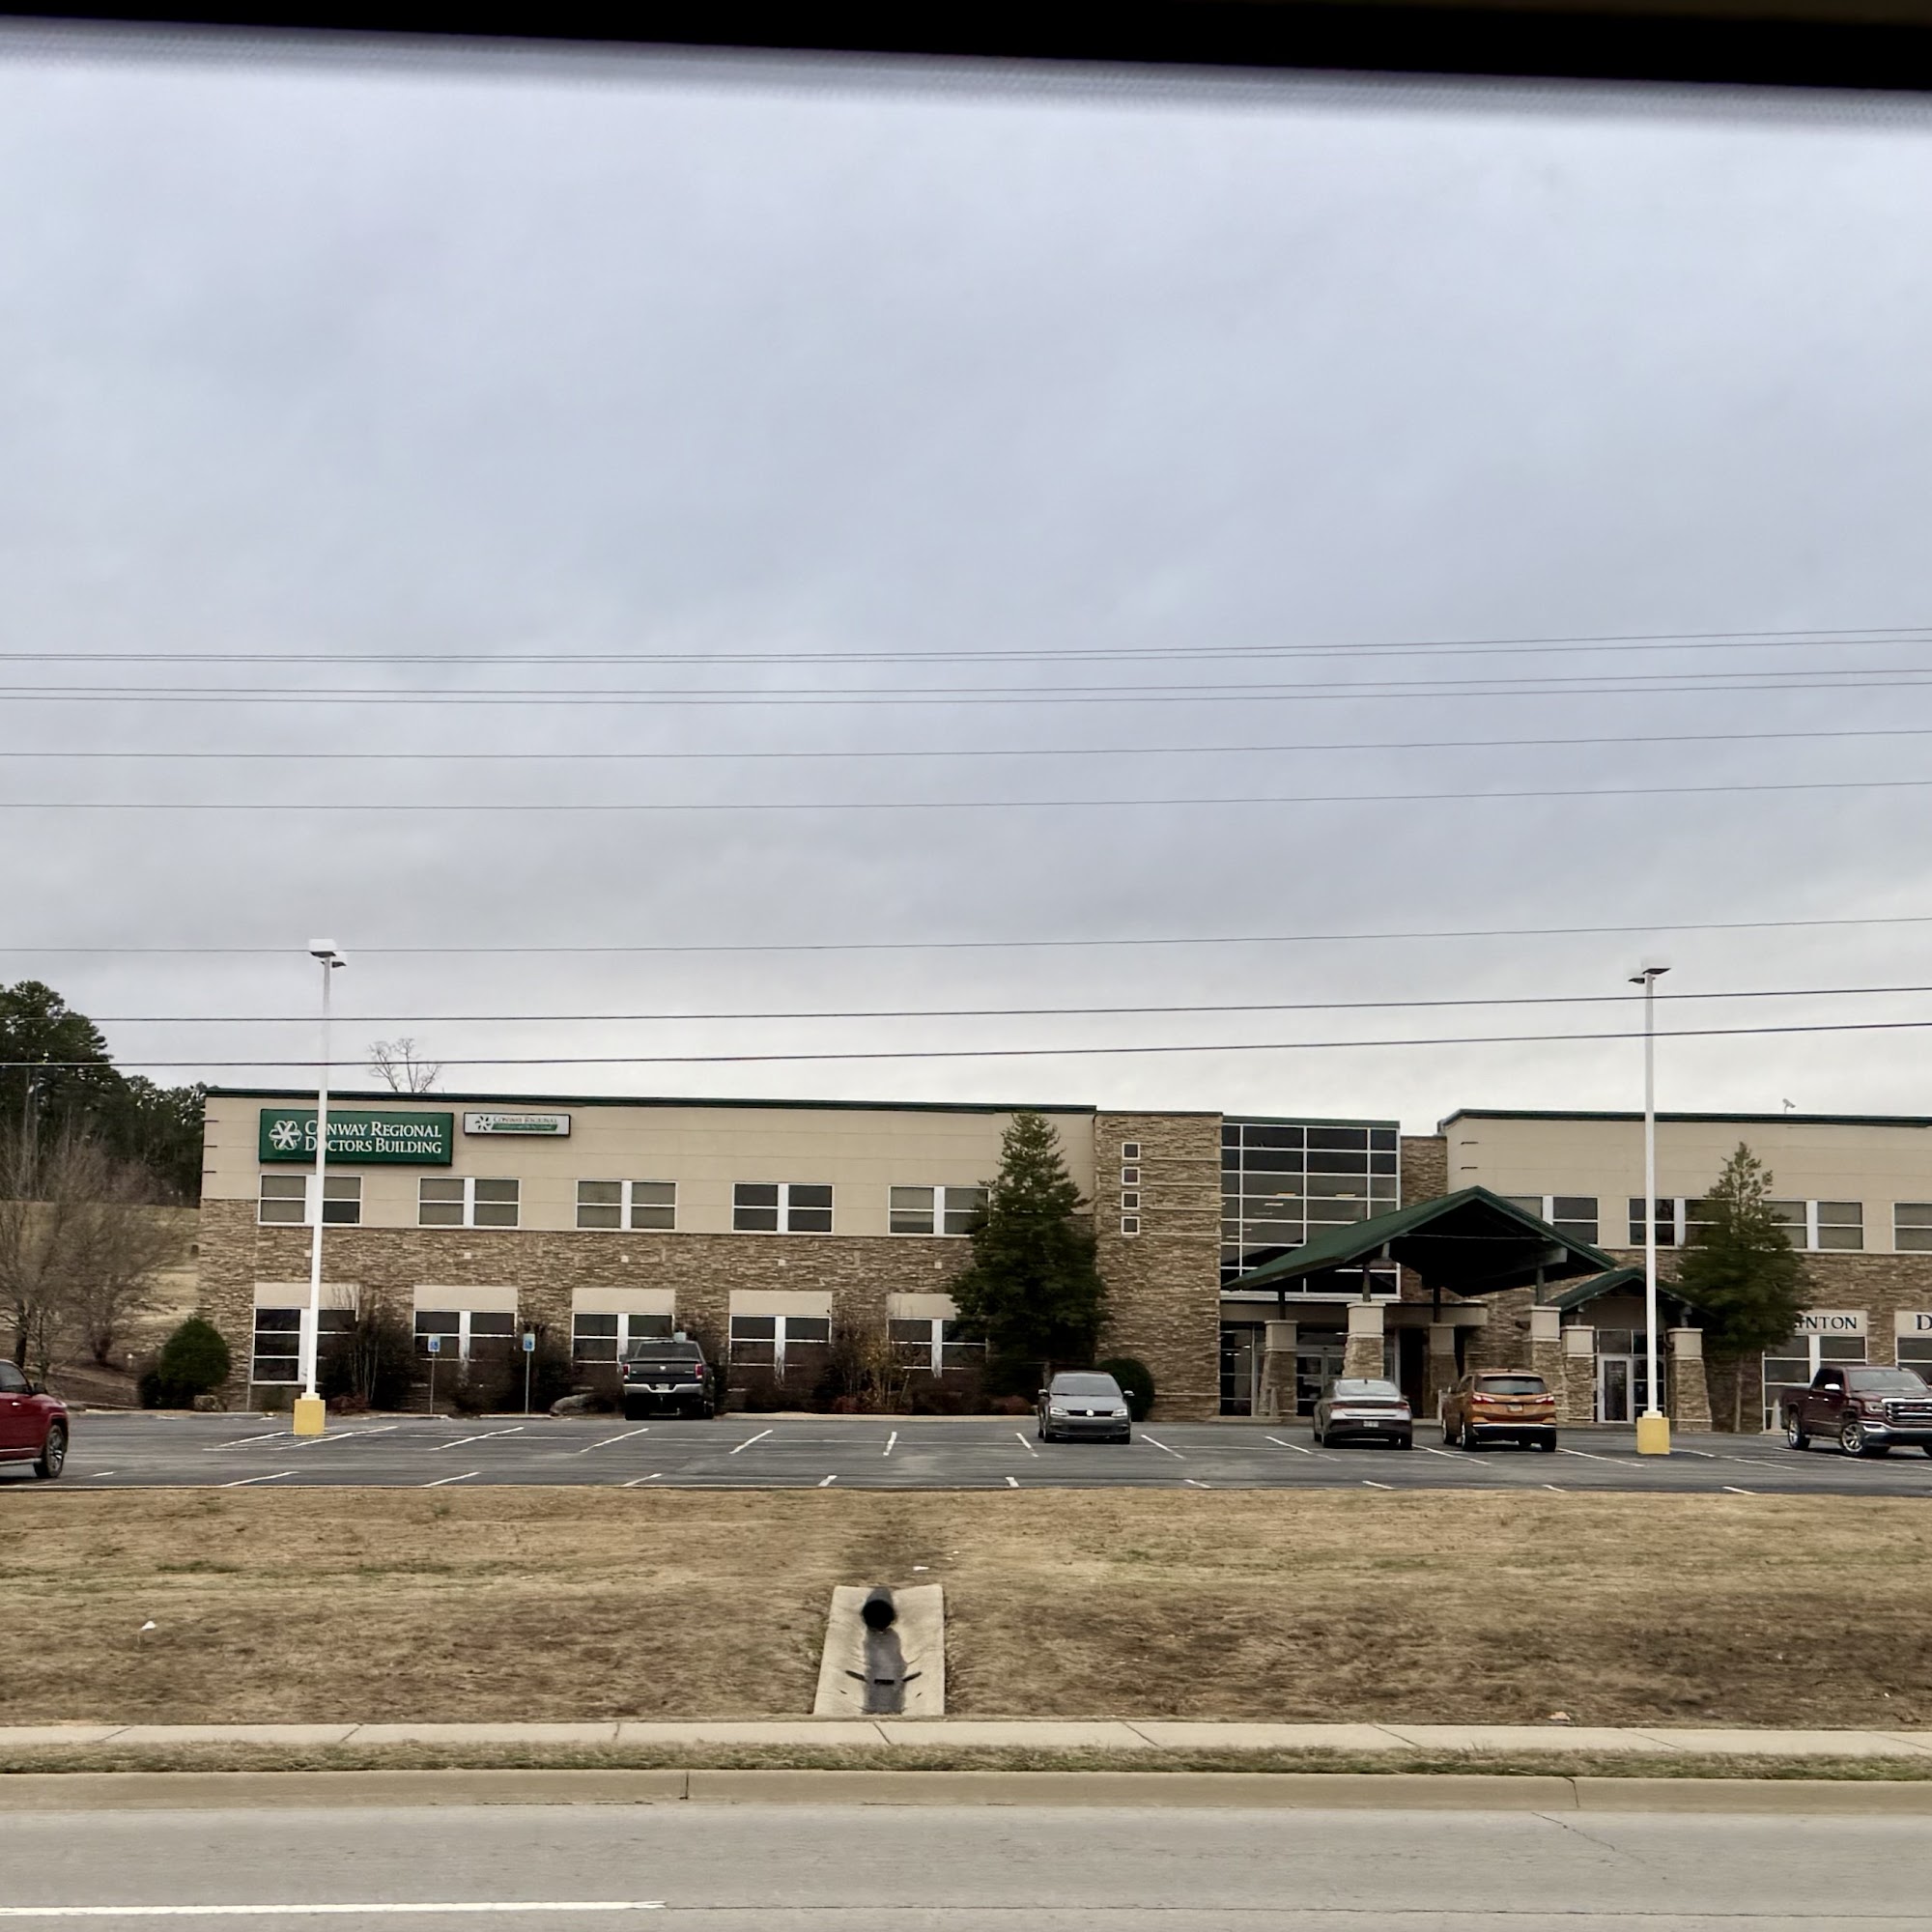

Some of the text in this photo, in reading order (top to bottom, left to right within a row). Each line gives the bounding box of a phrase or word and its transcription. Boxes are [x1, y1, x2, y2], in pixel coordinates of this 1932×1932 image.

[304, 1120, 442, 1138] CNWAY REGIONAL
[304, 1136, 442, 1154] DCTORS BUILDING
